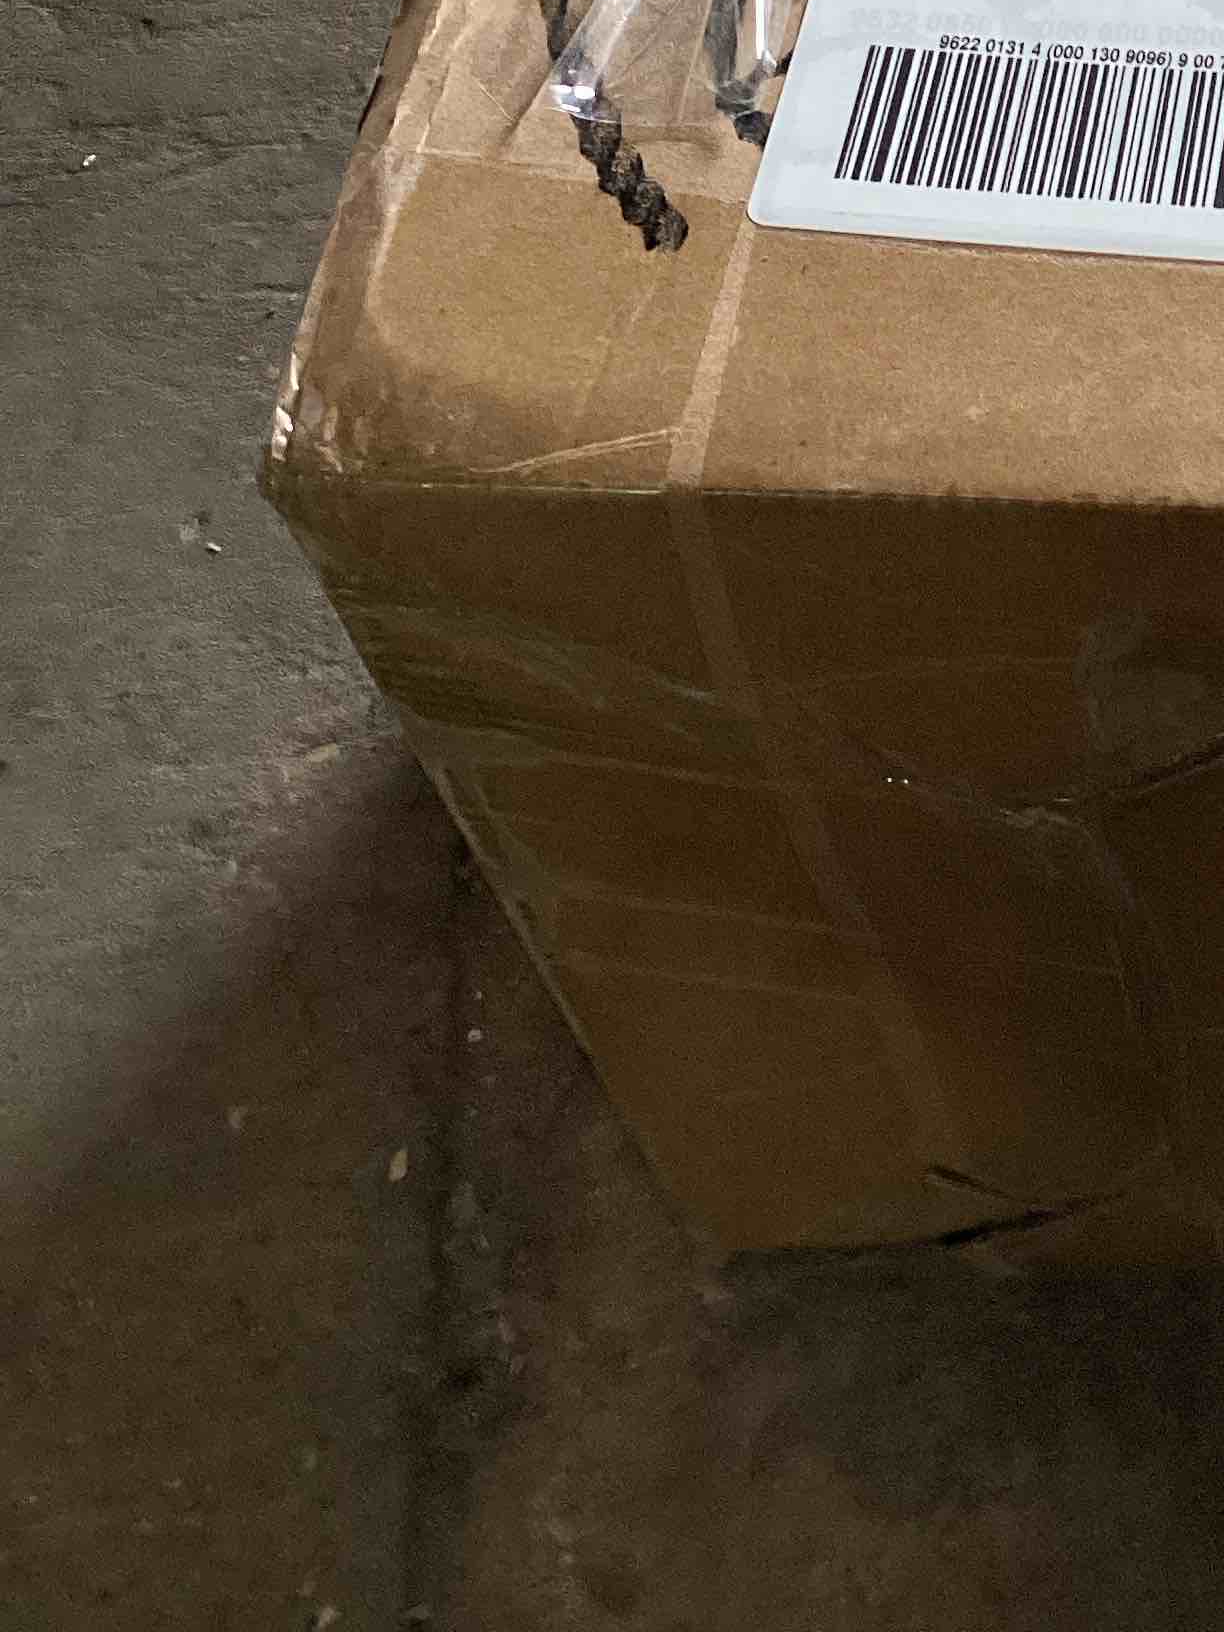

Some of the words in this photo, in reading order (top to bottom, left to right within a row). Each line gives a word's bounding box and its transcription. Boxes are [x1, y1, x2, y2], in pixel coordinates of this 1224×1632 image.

[939, 34, 981, 51] 9622
[985, 38, 1025, 55] 0131
[1031, 41, 1041, 56] 4
[1047, 43, 1084, 61] (000
[1091, 47, 1120, 62] 130
[1126, 48, 1172, 68] 9096)
[1177, 52, 1188, 67] 9
[1193, 54, 1214, 69] 00
